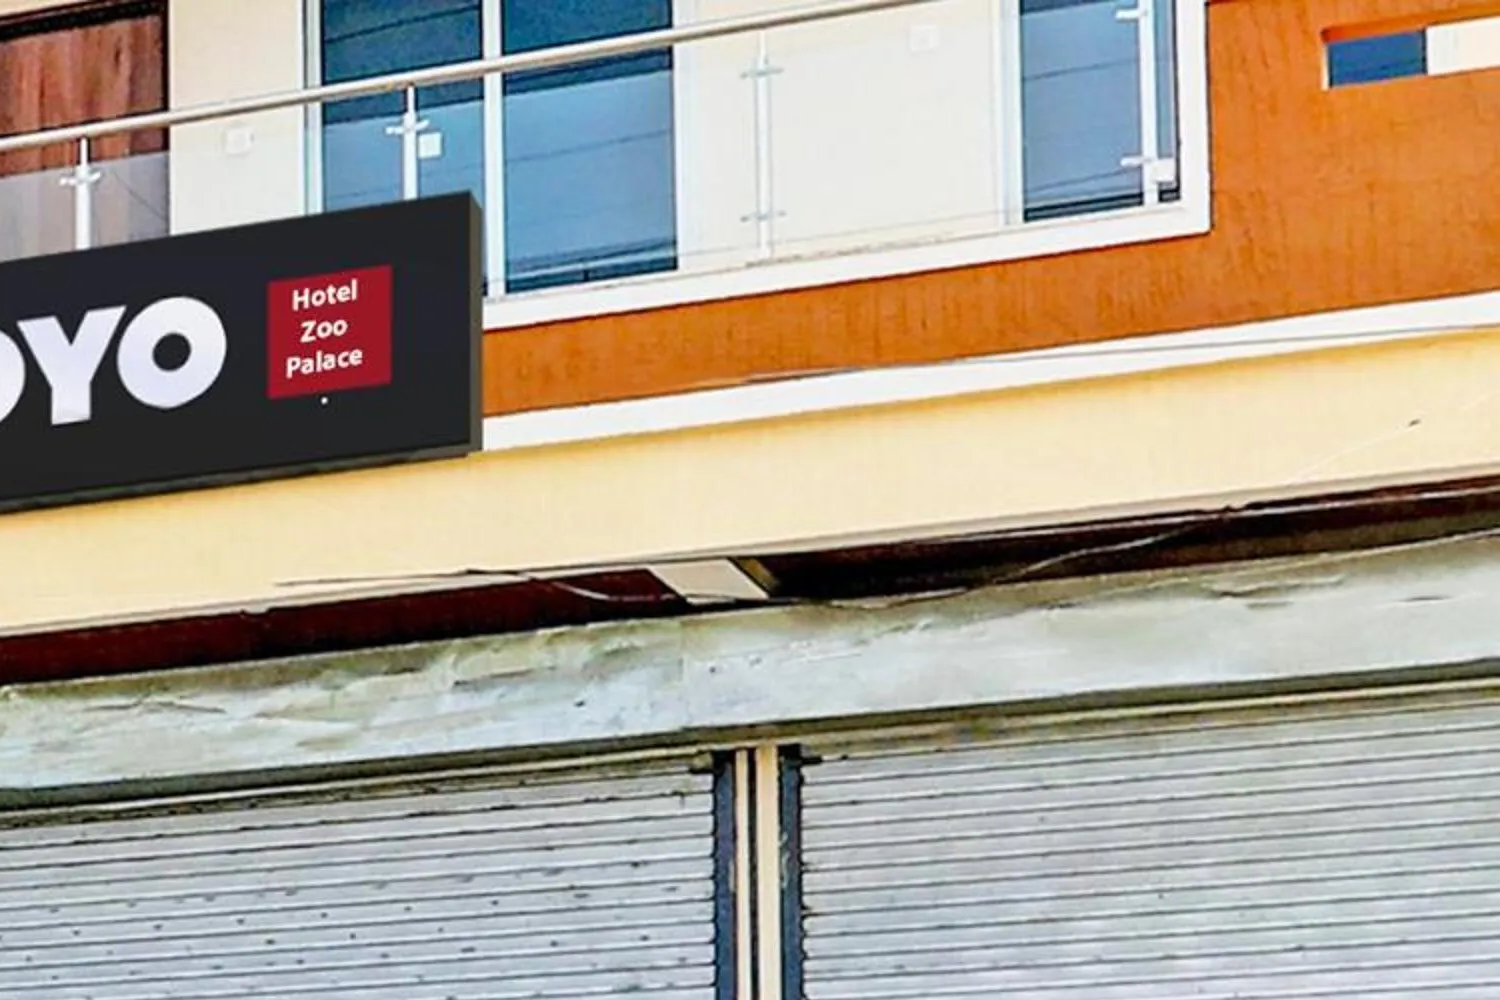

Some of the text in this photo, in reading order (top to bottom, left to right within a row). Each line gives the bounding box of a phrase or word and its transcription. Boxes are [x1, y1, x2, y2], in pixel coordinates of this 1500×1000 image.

[292, 278, 358, 312] Hotel
[299, 319, 349, 343] Zoo
[286, 347, 363, 379] Palace
